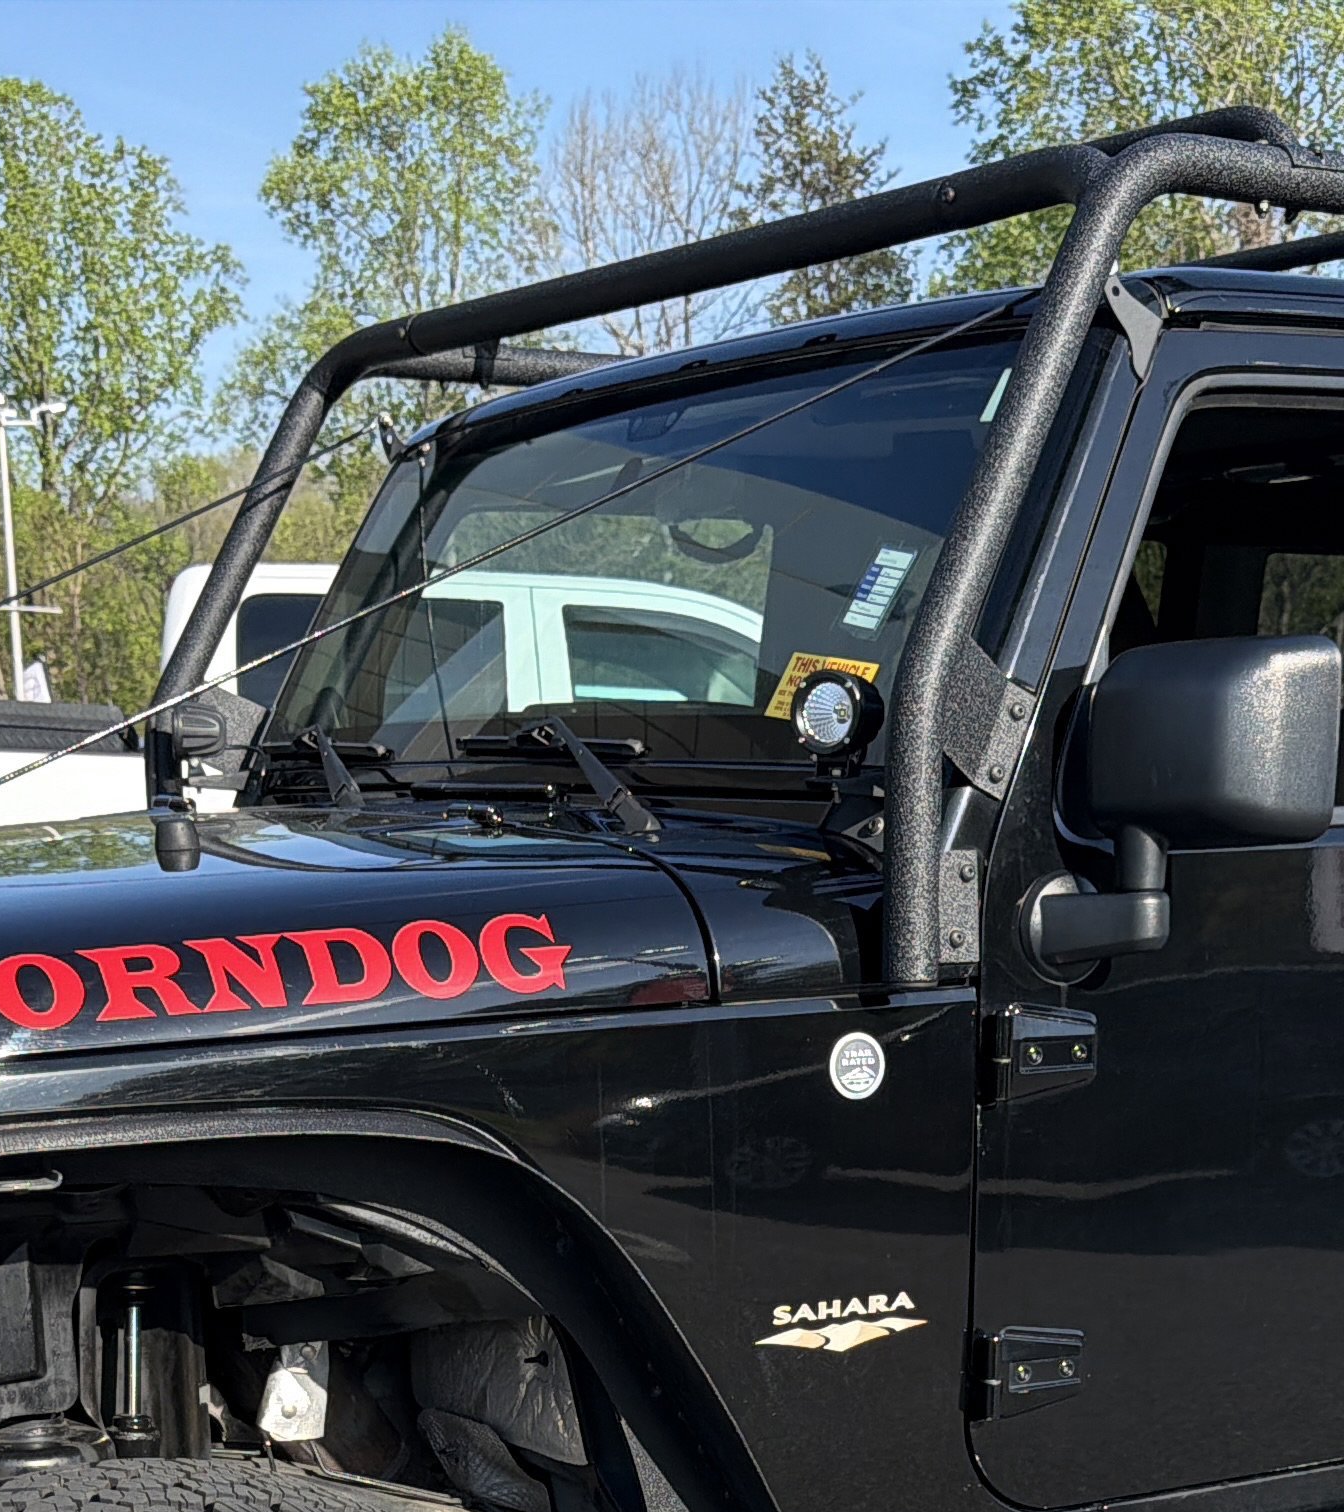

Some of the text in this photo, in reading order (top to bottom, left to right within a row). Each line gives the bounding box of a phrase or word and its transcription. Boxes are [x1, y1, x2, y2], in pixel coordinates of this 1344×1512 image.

[792, 656, 820, 673] THIS
[843, 1048, 874, 1059] TRAIL
[841, 1057, 876, 1067] RATED
[772, 1291, 916, 1327] SAHARA
